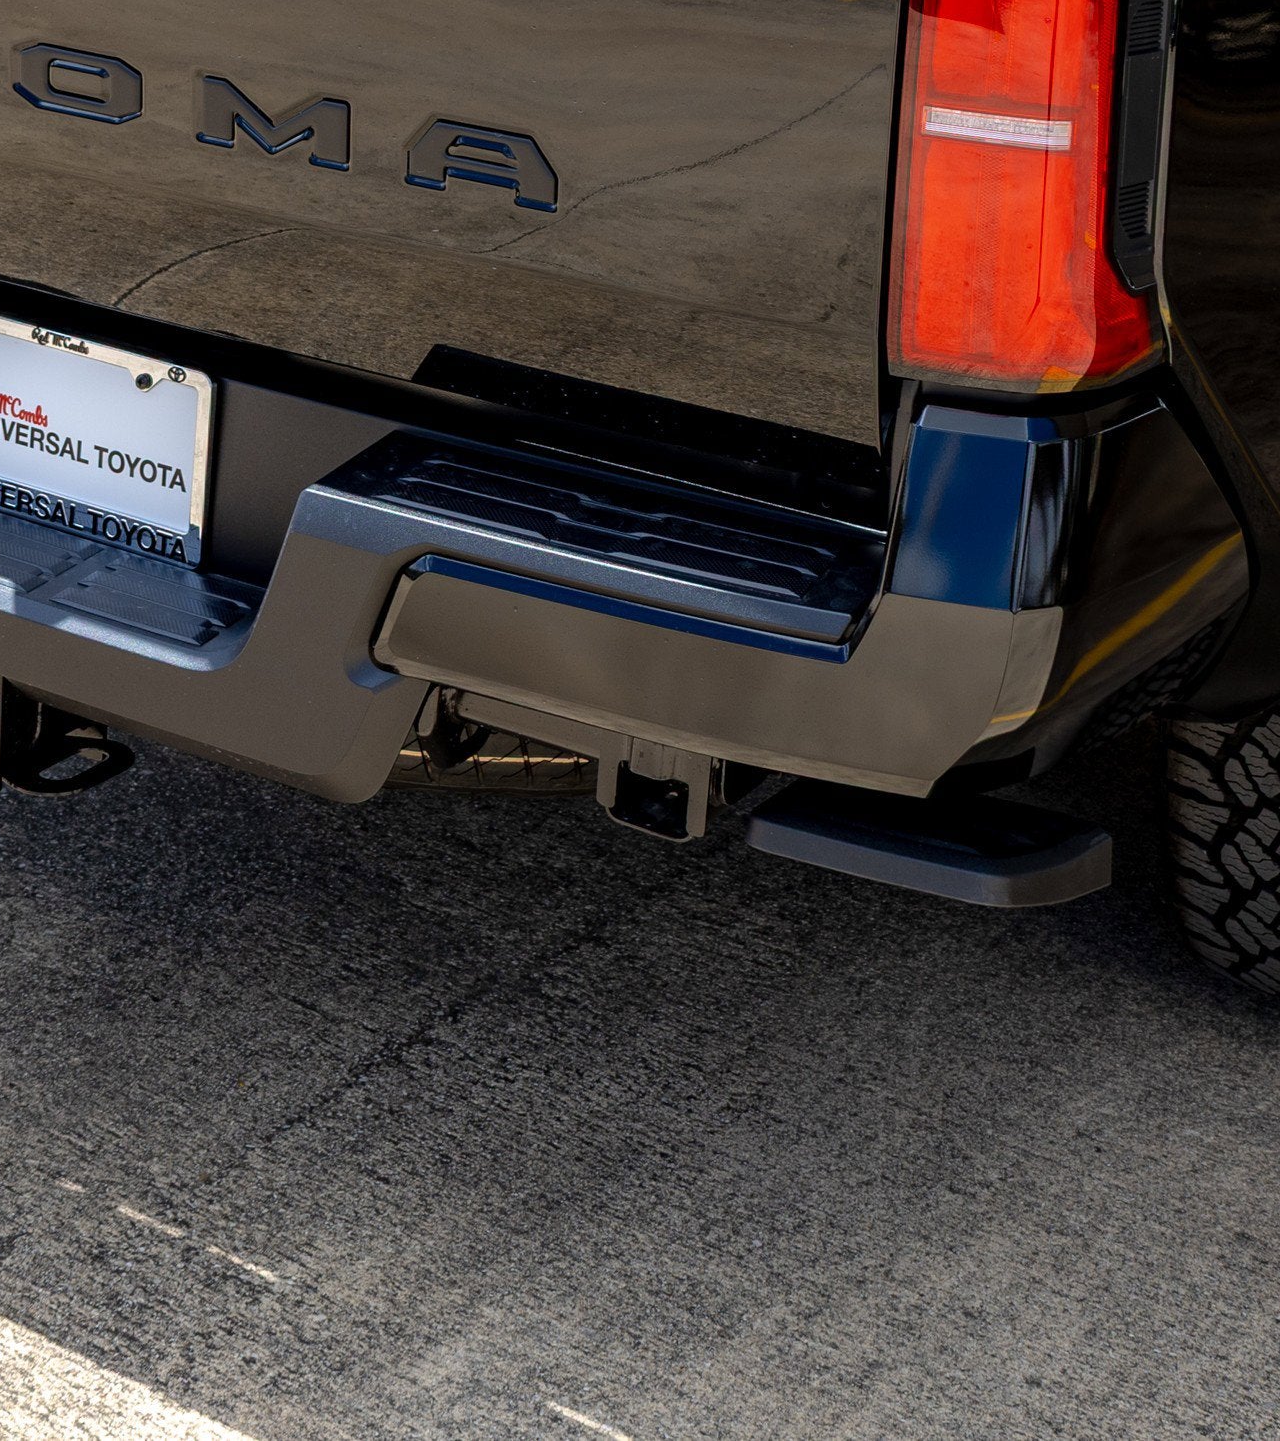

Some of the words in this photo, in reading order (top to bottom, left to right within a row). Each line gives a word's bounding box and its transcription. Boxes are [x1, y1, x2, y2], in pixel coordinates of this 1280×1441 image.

[32, 327, 49, 345] Red
[94, 445, 186, 493] TOYOTA
[87, 509, 188, 563] TOYOTA
